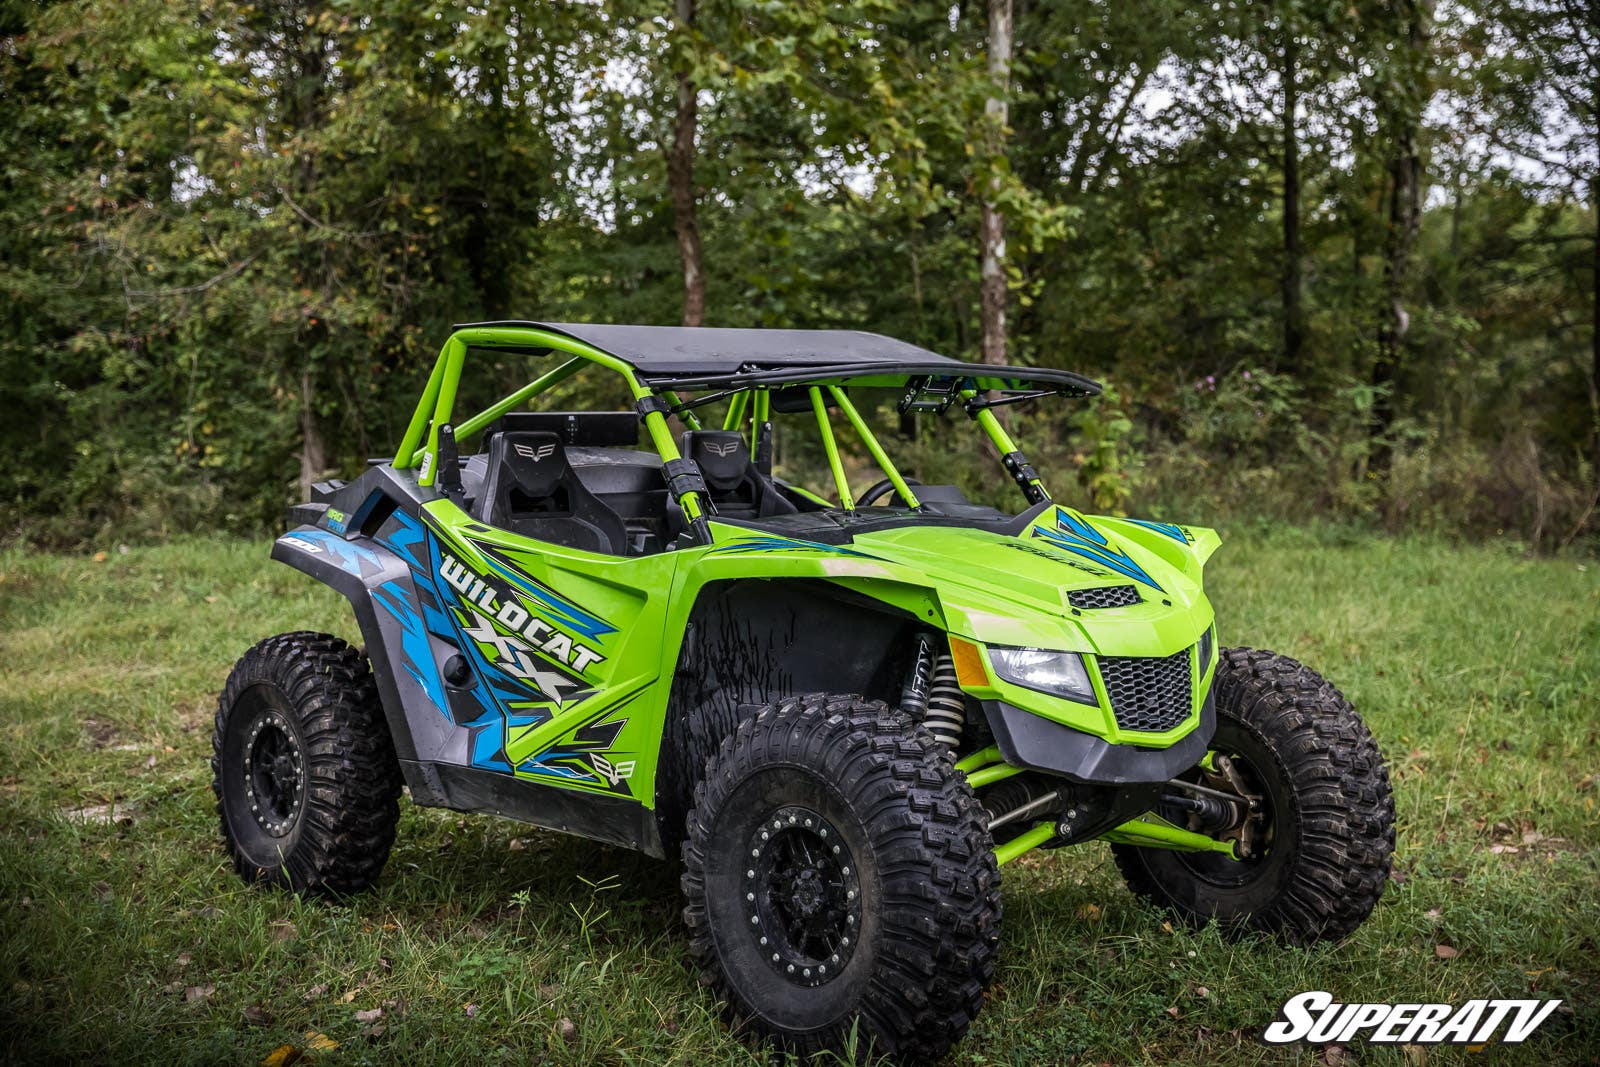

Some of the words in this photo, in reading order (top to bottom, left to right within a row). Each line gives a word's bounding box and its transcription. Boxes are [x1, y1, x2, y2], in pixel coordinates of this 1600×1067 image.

[439, 554, 605, 673] WILDCAT
[460, 608, 578, 706] XX
[911, 640, 930, 699] FOX
